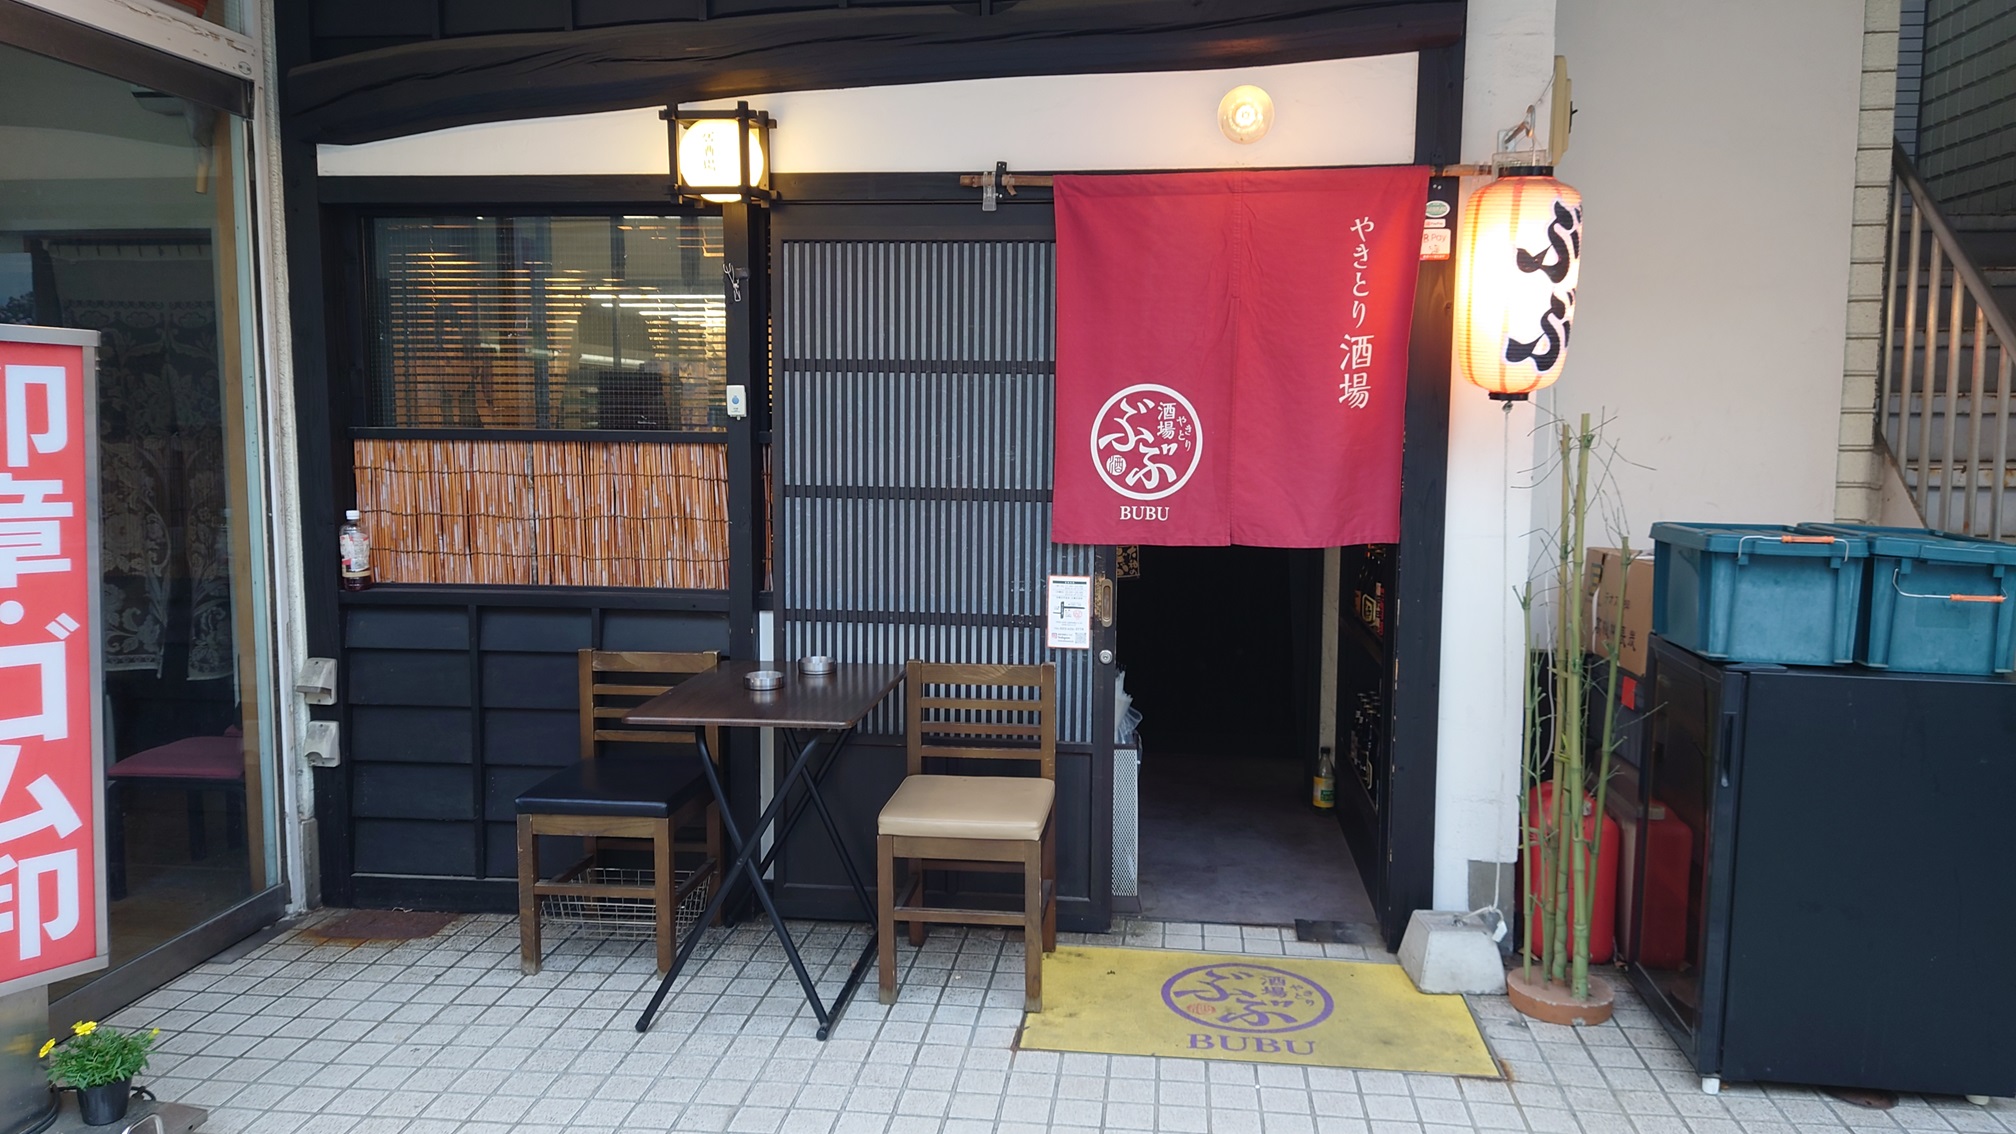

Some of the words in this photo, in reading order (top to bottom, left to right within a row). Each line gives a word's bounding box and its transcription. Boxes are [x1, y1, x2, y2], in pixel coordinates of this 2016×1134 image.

[1505, 200, 1582, 372] ぶぶ
[1338, 216, 1375, 409] やきとり酒場
[1098, 397, 1178, 490] ぶぶ
[1157, 401, 1177, 440] 酒場
[1119, 505, 1170, 521] BUBU
[1173, 969, 1299, 1027] ぶぶ
[1261, 975, 1288, 998] 酒場
[1186, 1033, 1316, 1055] BUBU
